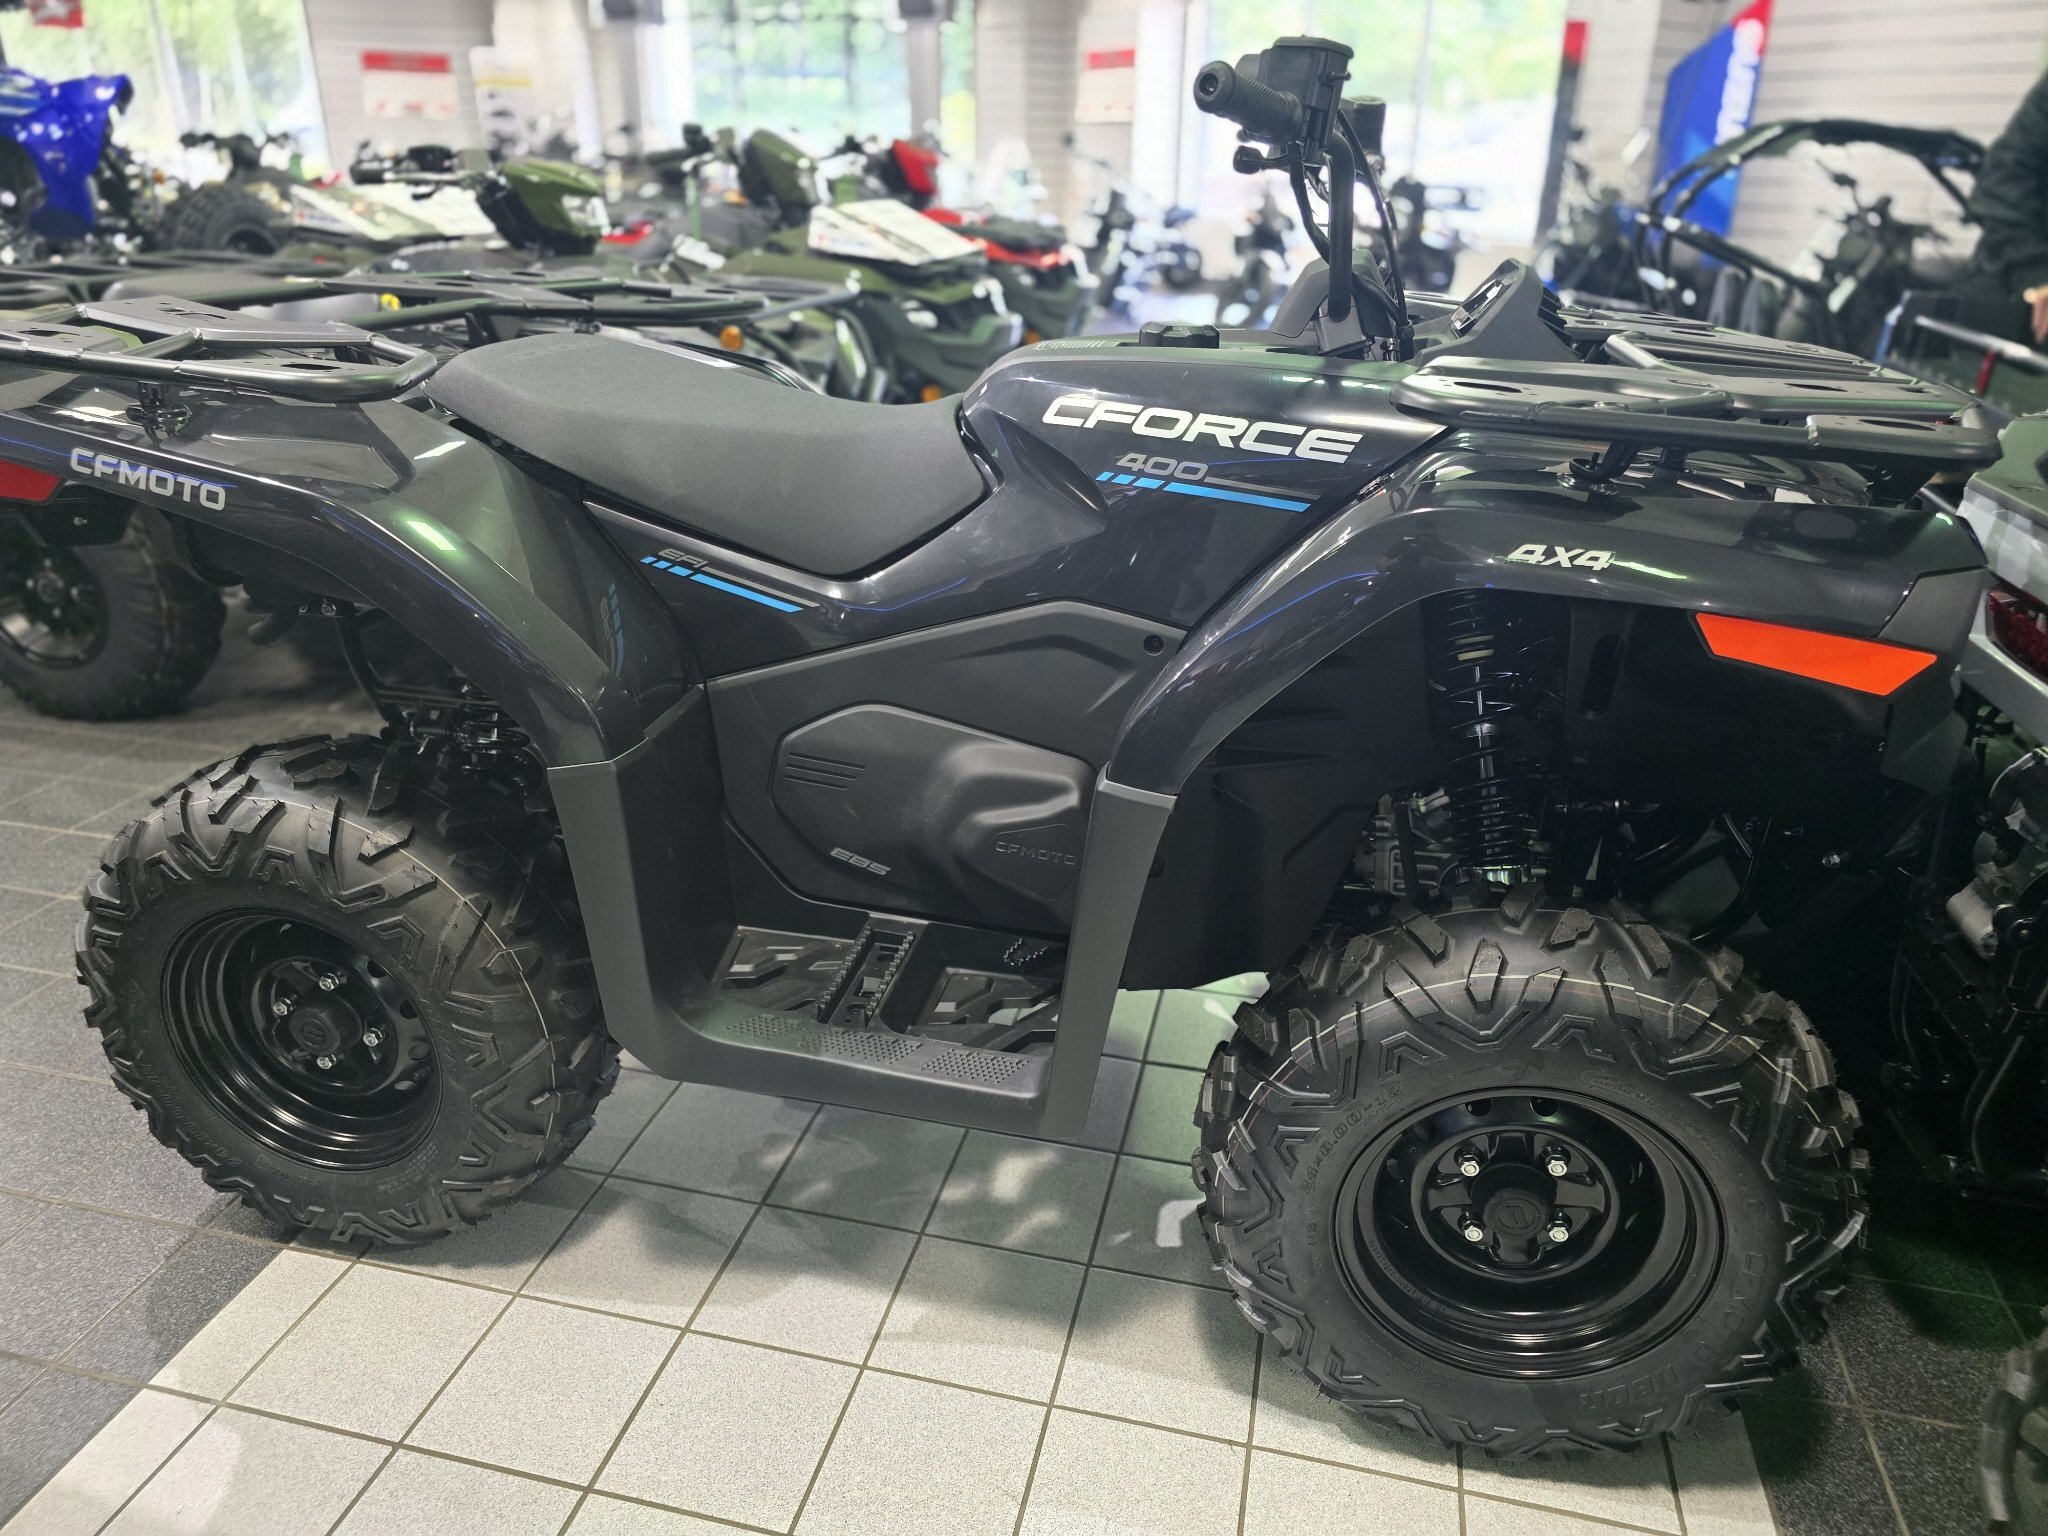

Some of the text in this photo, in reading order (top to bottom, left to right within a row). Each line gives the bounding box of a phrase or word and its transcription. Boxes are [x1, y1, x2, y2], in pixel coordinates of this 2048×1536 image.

[1042, 393, 1365, 464] CFORCE
[70, 447, 226, 511] CFMOTO
[1116, 452, 1209, 482] 400
[657, 548, 708, 569] EFI
[830, 847, 892, 876] EBS
[995, 841, 1076, 866] CFMOTO
